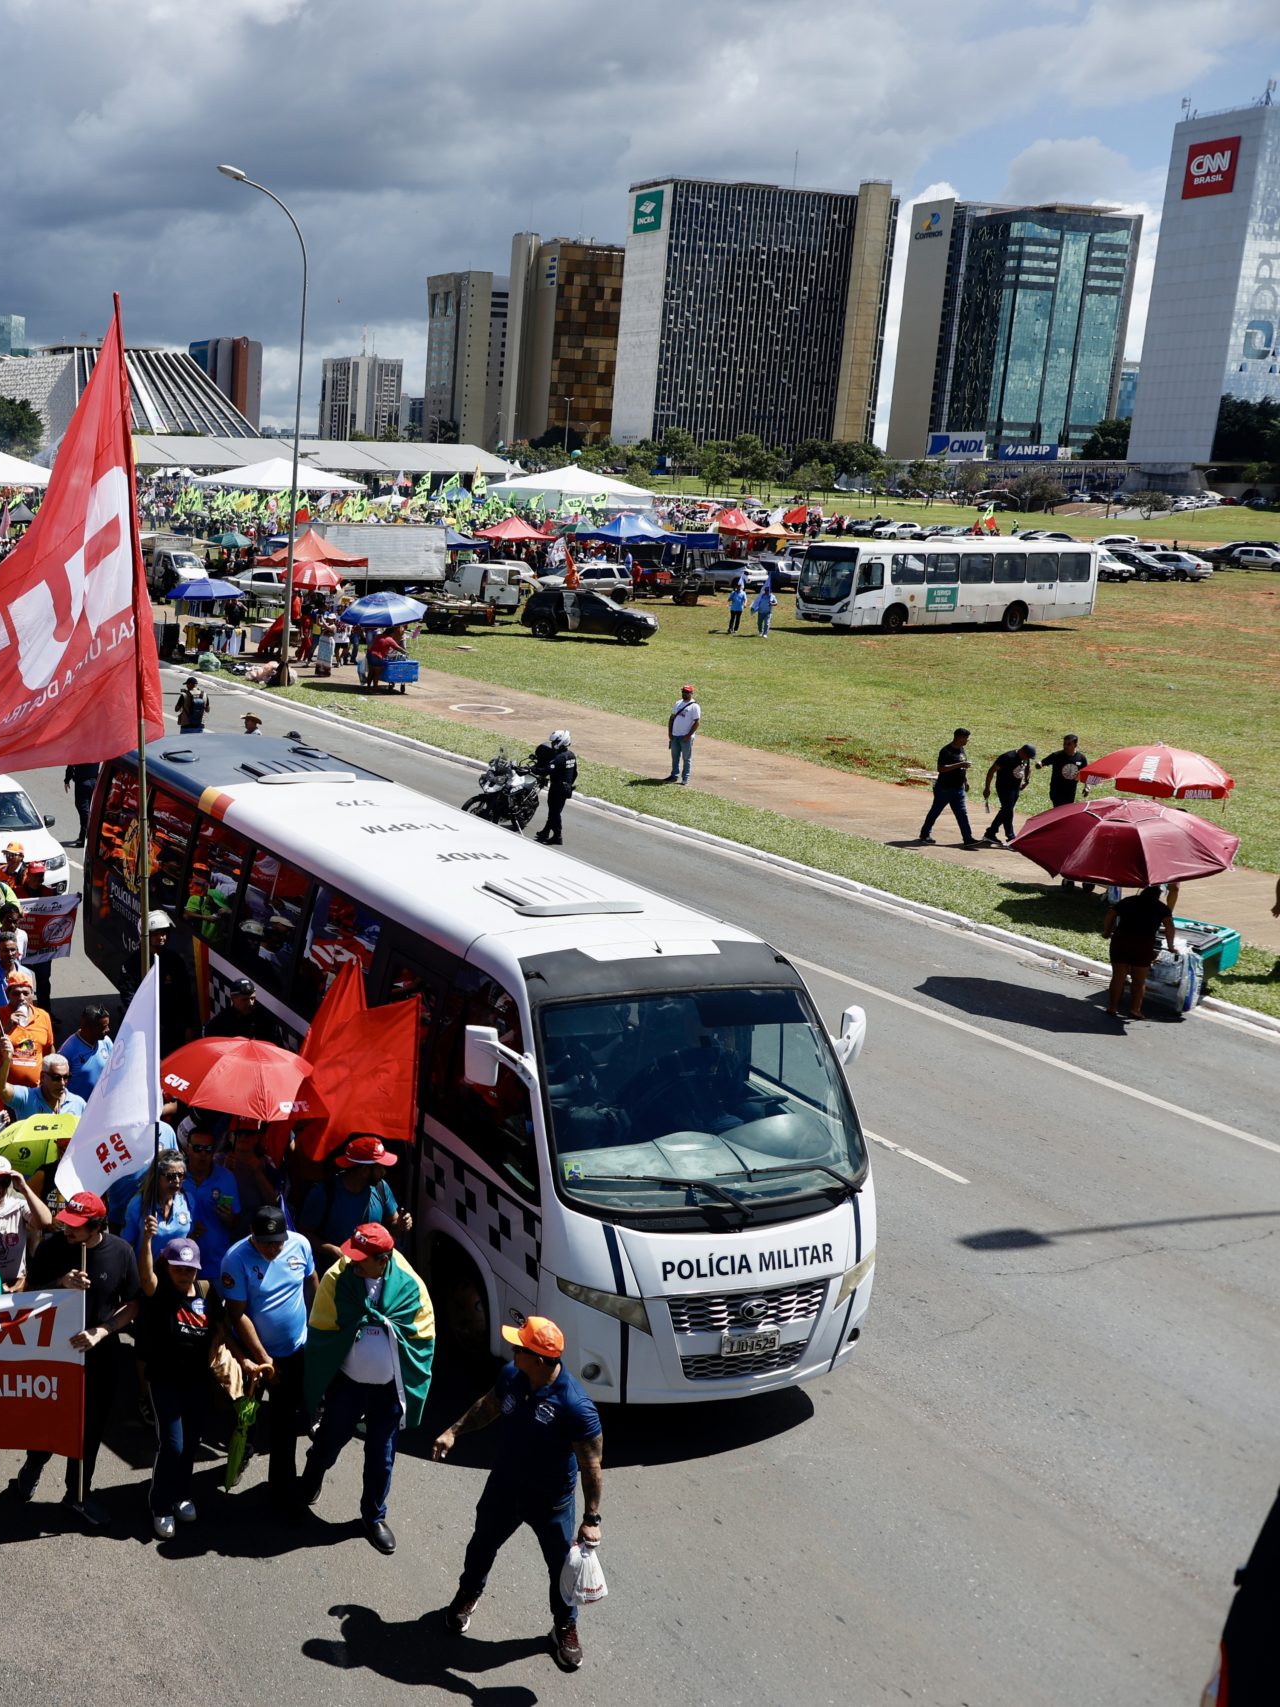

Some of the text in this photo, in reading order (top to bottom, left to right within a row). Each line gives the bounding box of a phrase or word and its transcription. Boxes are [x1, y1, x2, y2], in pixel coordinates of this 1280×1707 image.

[1190, 150, 1231, 176] CNN
[1193, 174, 1223, 186] BRASIL
[914, 229, 943, 241] Correios
[949, 439, 985, 454] CNDL
[1016, 445, 1050, 456] ANFIP
[1184, 789, 1213, 799] BRAHMA
[435, 852, 510, 863] PMDF
[164, 1073, 190, 1091] CUT
[109, 1132, 132, 1162] CUT
[662, 1242, 833, 1282] POLÍCIA MILITAR
